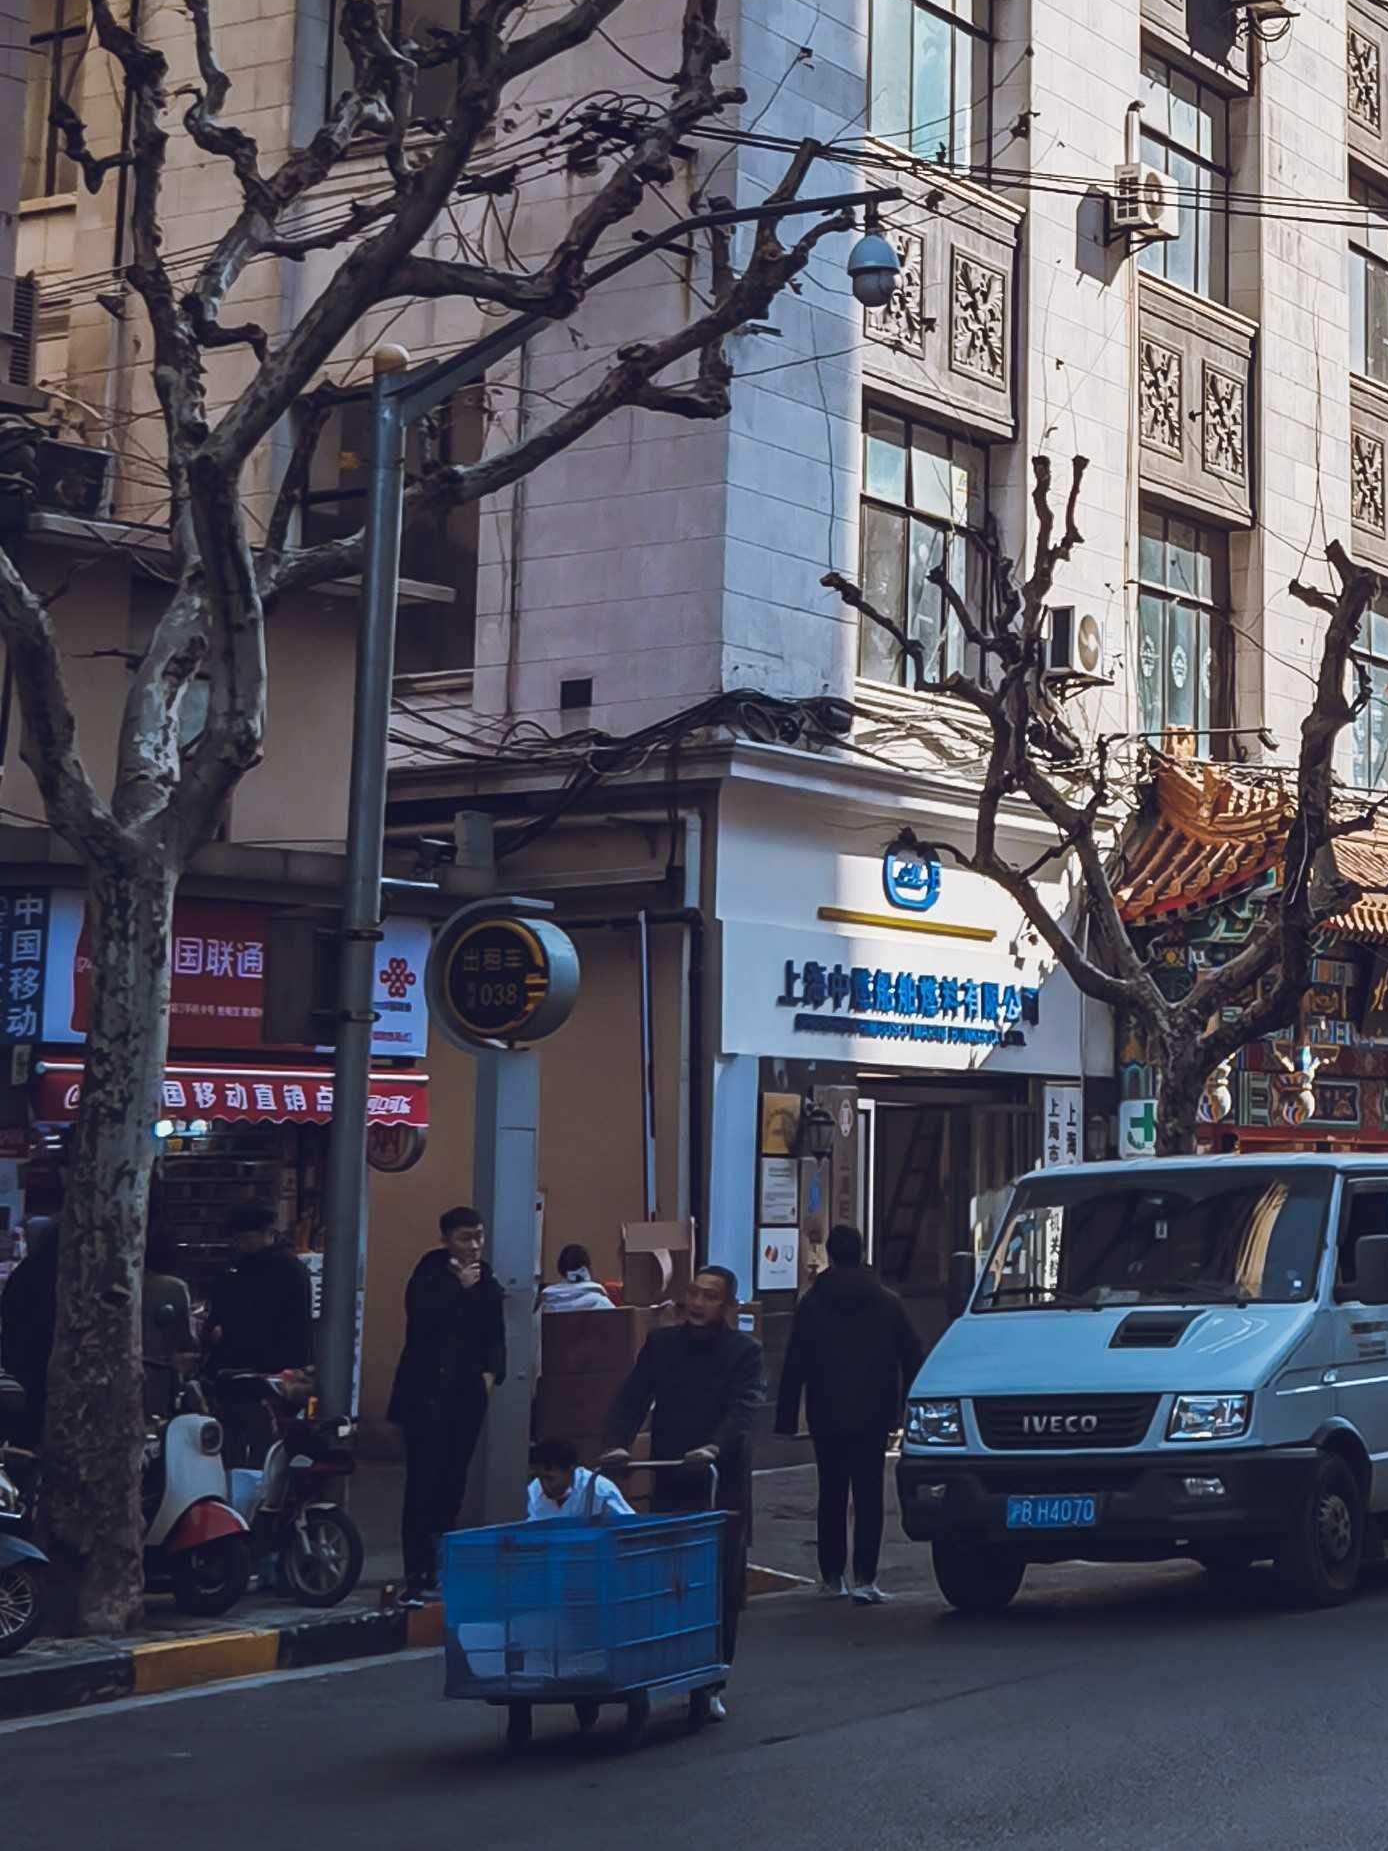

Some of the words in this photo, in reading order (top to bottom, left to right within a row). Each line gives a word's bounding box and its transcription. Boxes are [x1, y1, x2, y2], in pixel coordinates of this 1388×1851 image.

[6, 892, 43, 1037] 中国移动
[174, 936, 264, 979] 国联通
[480, 982, 518, 1006] 038
[159, 1079, 334, 1112] 国移动直销点
[1023, 1414, 1098, 1433] IVECO
